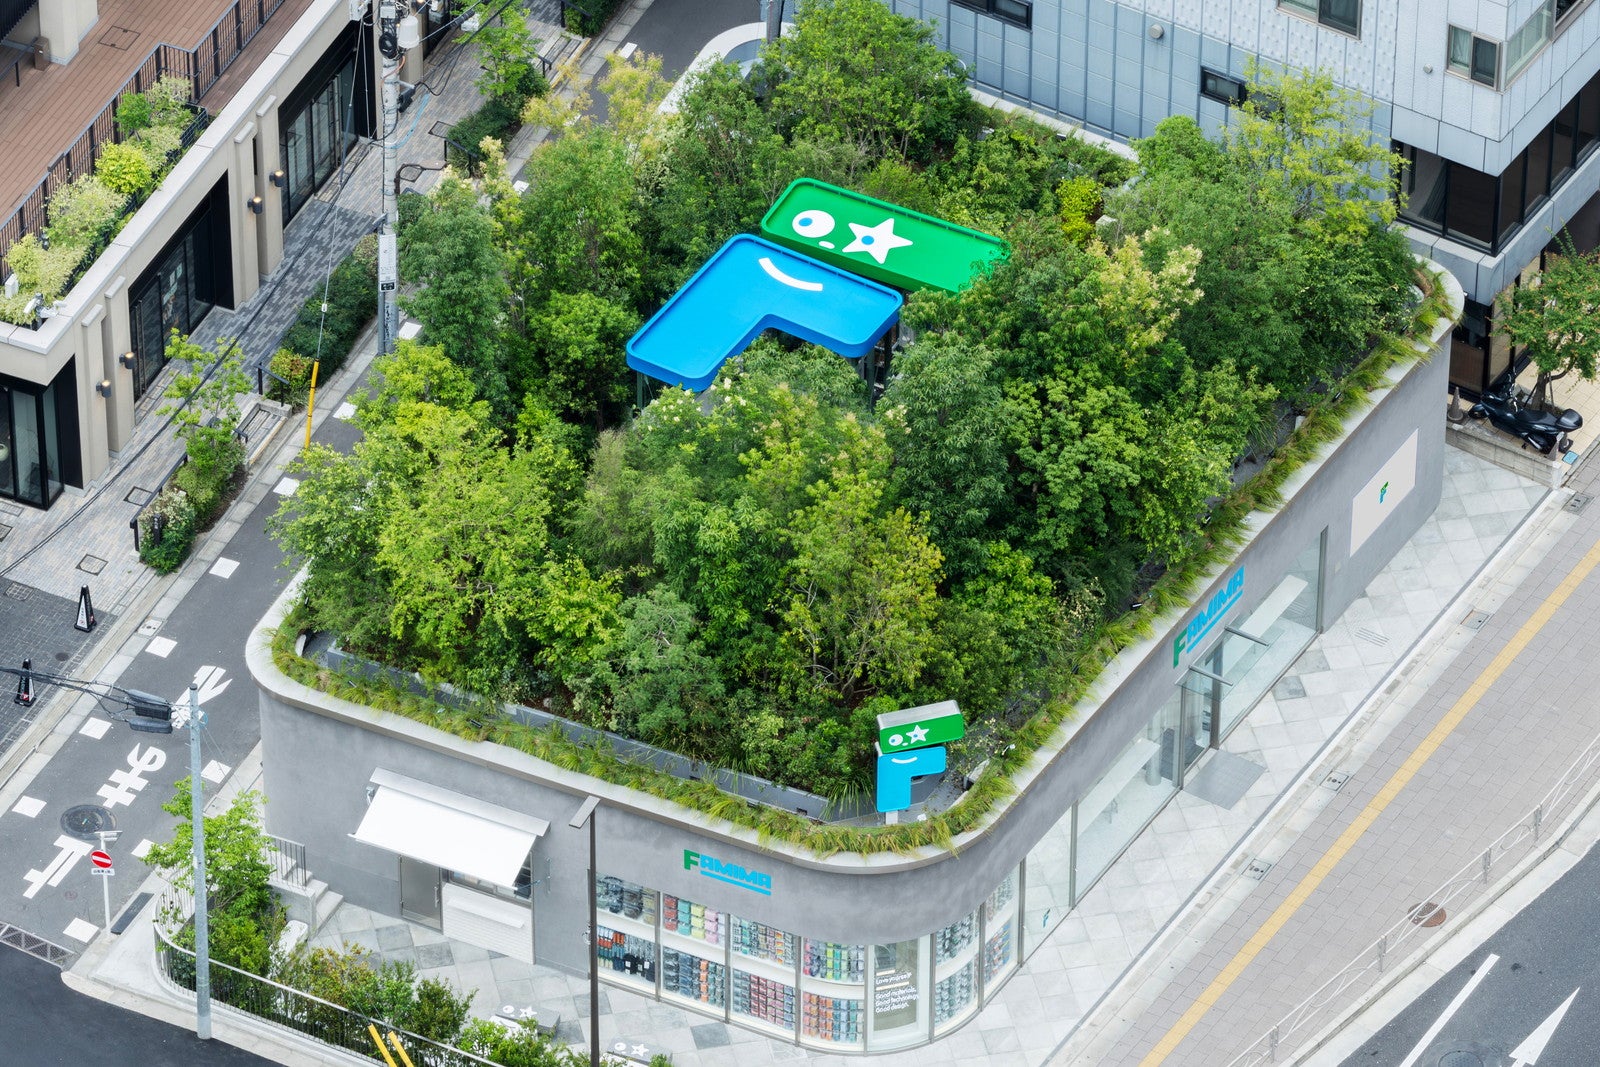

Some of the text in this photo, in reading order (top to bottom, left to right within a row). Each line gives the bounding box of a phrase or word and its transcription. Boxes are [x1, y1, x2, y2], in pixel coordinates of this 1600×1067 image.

[1173, 565, 1245, 669] FAMIMA
[683, 848, 772, 891] FAMIMA
[875, 991, 891, 999] Good
[875, 998, 891, 1006] Good
[875, 1005, 891, 1014] Good
